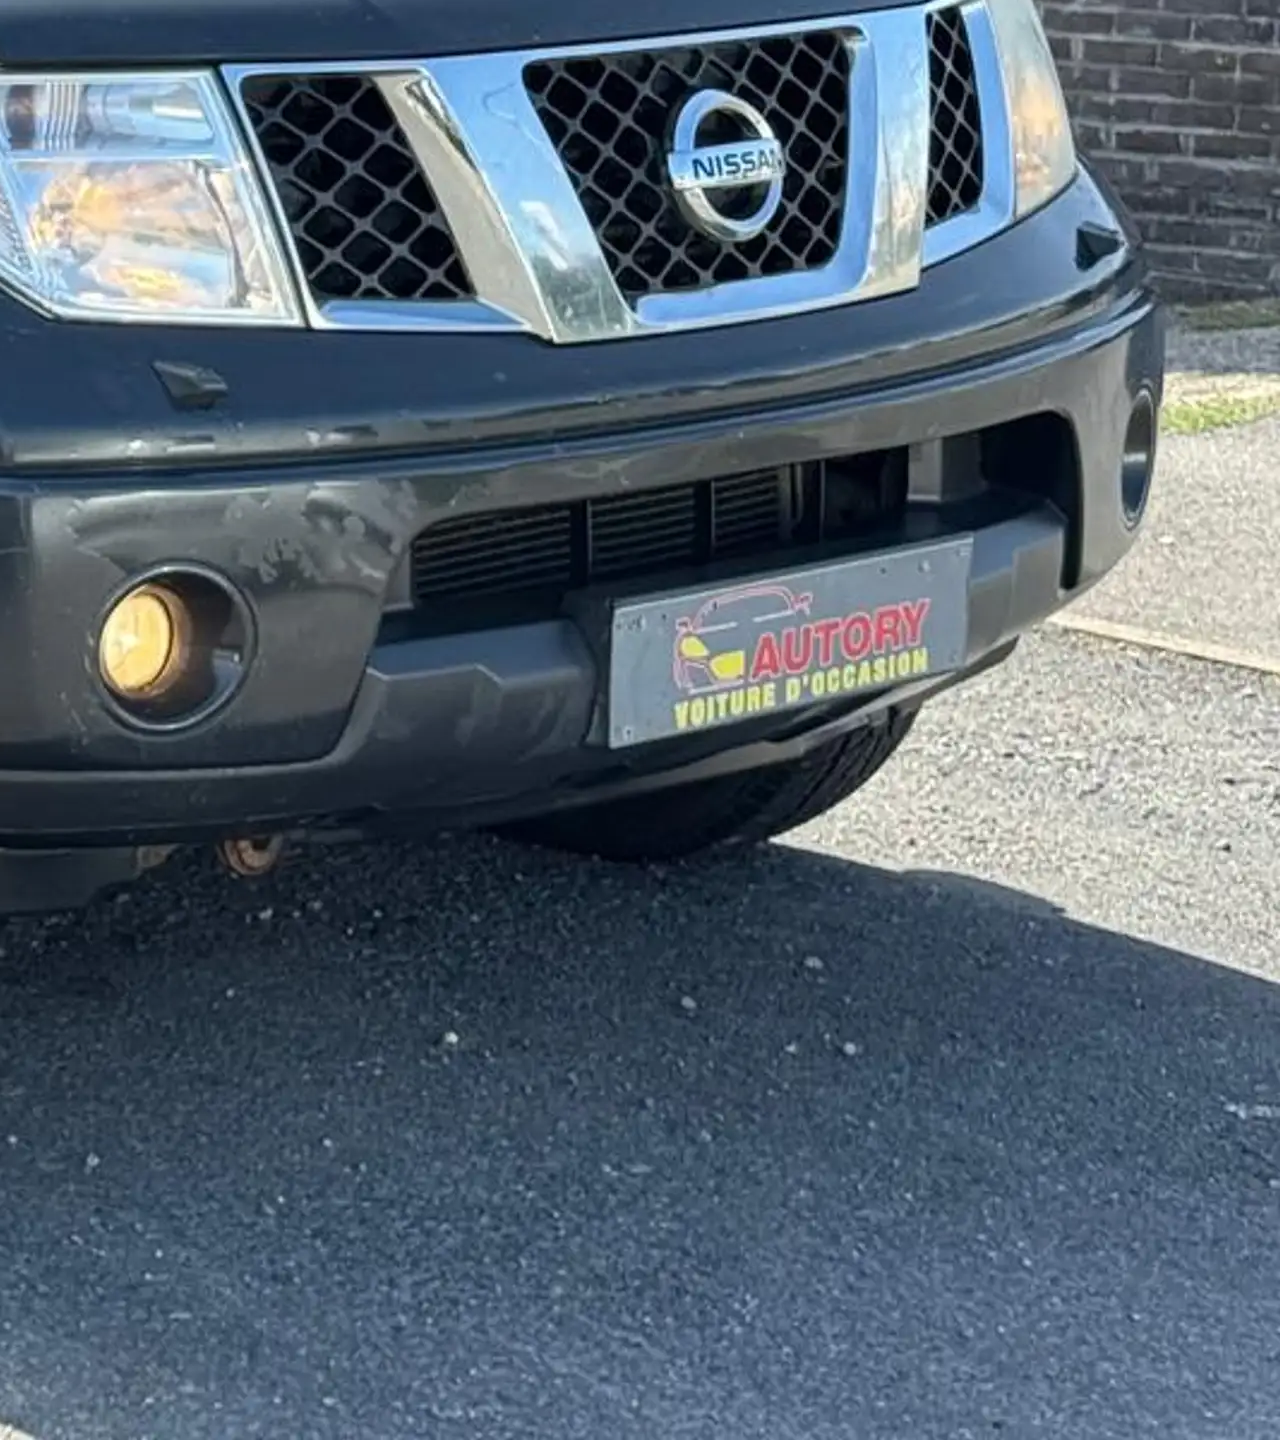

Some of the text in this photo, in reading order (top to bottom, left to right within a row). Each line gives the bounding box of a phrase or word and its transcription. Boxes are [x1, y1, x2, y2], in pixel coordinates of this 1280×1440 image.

[748, 598, 931, 682] AUTORY
[674, 647, 929, 730] VOITURE D'OCCASION
